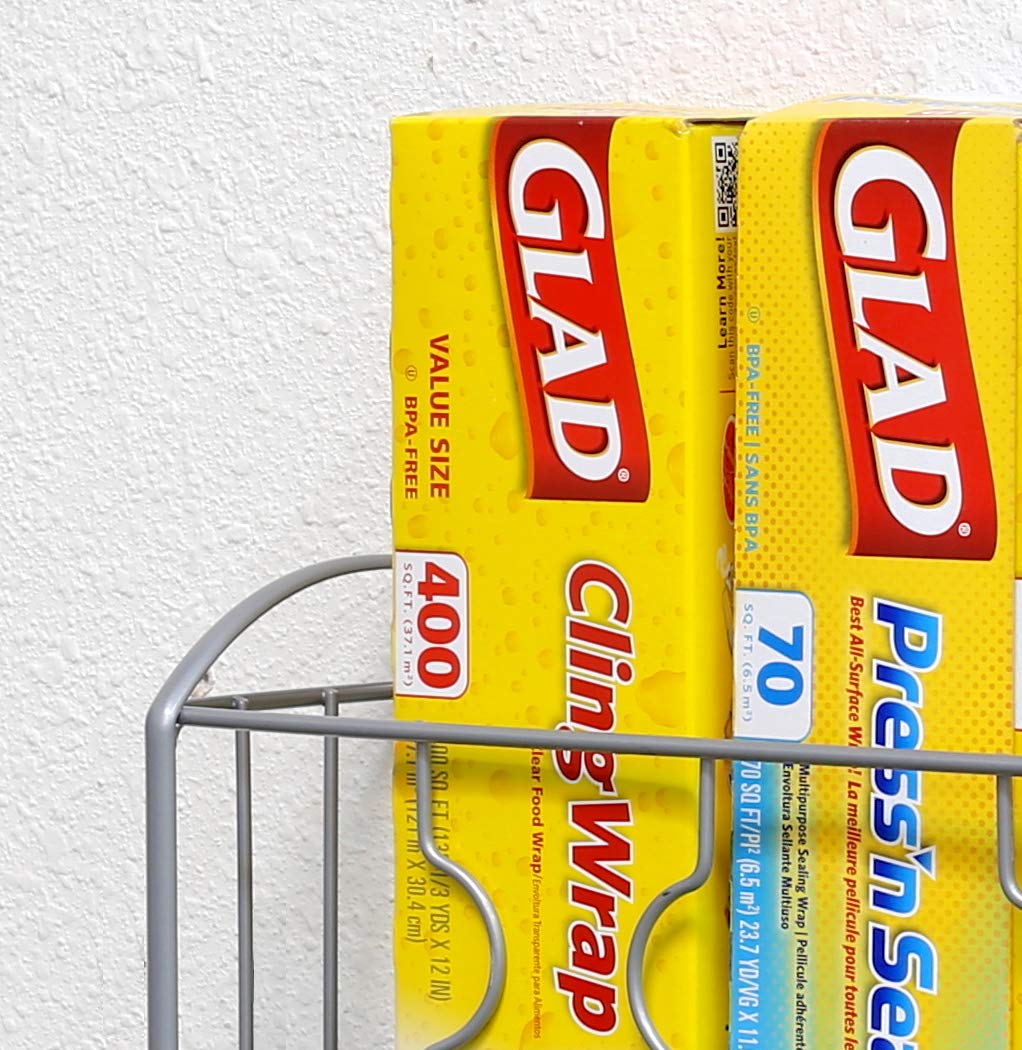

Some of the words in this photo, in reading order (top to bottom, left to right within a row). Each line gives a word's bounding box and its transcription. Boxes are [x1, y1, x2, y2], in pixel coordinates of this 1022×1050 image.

[715, 237, 727, 290] More!
[507, 138, 622, 482] GLAD
[717, 297, 729, 349] Learn
[834, 146, 963, 536] GLAD
[429, 334, 450, 428] VALUE
[745, 345, 761, 437] BPA-FREE
[404, 396, 419, 499] BPA-FREE
[429, 439, 450, 499] SIZE
[744, 454, 760, 508] SANS
[743, 513, 759, 553] BPA
[417, 561, 461, 689] 400
[848, 596, 864, 631] Best
[551, 557, 637, 795] Cling
[757, 626, 804, 706] 70
[848, 634, 864, 721] All-Surface
[531, 787, 544, 827] Food
[740, 784, 761, 804] SQ
[782, 763, 793, 821] Envoltura
[796, 764, 810, 846] Multipurpose
[846, 781, 862, 801] La
[781, 823, 793, 873] Sellante
[845, 803, 862, 875] meilleure
[407, 877, 426, 911] 30.4
[736, 858, 761, 888] (6.5
[795, 850, 809, 893] Sealing
[430, 904, 450, 933] YDS
[553, 800, 634, 1036] Wrap
[780, 876, 792, 930] Multiuso
[795, 896, 809, 929] Wrap
[843, 878, 860, 942] pellicule
[405, 917, 425, 943] cm)
[739, 919, 760, 954] 23.7
[430, 958, 449, 975] 12
[737, 959, 760, 1007] YD/VG
[796, 939, 808, 990] Pellicule
[843, 945, 857, 980] pour
[738, 1011, 759, 1023] X
[843, 985, 858, 1033] toutes
